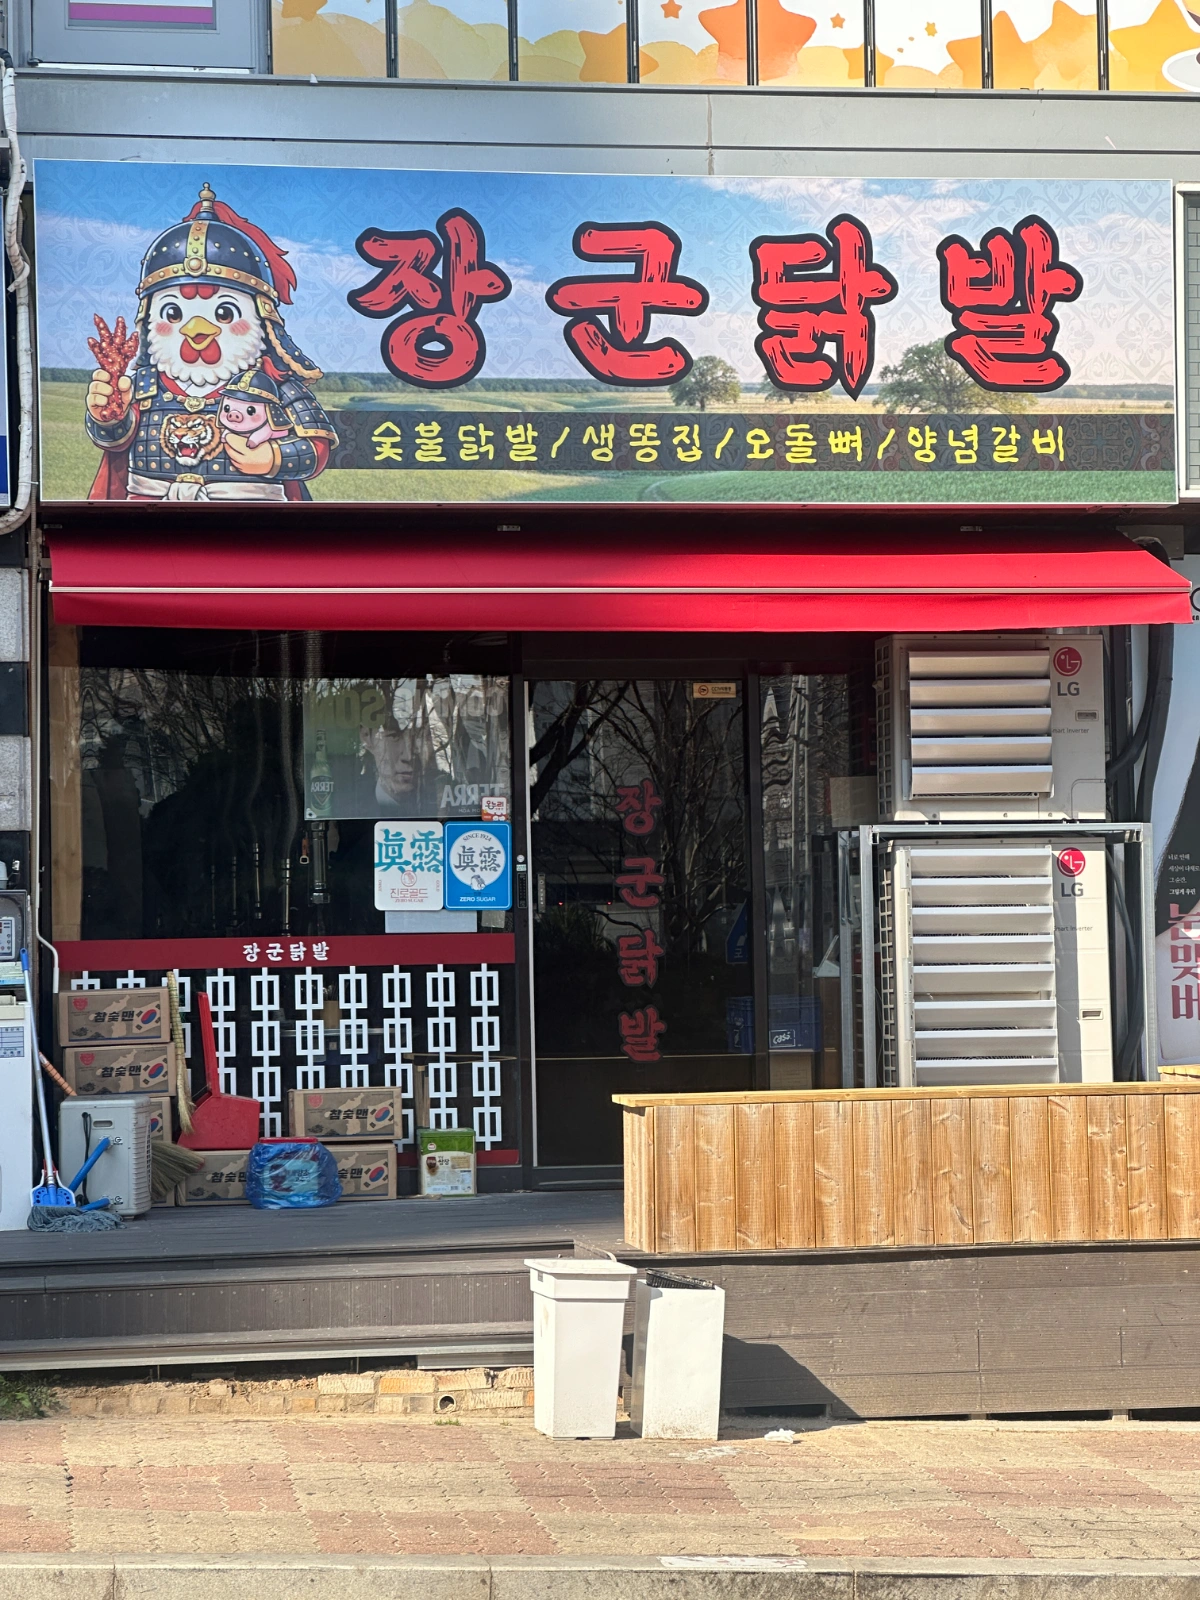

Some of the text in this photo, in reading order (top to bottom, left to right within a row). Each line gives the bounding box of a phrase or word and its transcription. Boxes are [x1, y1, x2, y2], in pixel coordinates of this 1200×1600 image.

[347, 207, 1084, 401] 장군닭발
[1057, 681, 1080, 697] LG
[375, 828, 444, 874] 眞露
[453, 845, 501, 873] 眞露
[390, 888, 428, 898] 진로골드
[1061, 882, 1084, 897] LG
[242, 941, 330, 962] 장군닭발
[94, 1010, 135, 1023] 참숯맨
[101, 1065, 143, 1078] 참숯맨
[329, 1108, 369, 1120] 참숯맨
[338, 1167, 364, 1179] 숯맨
